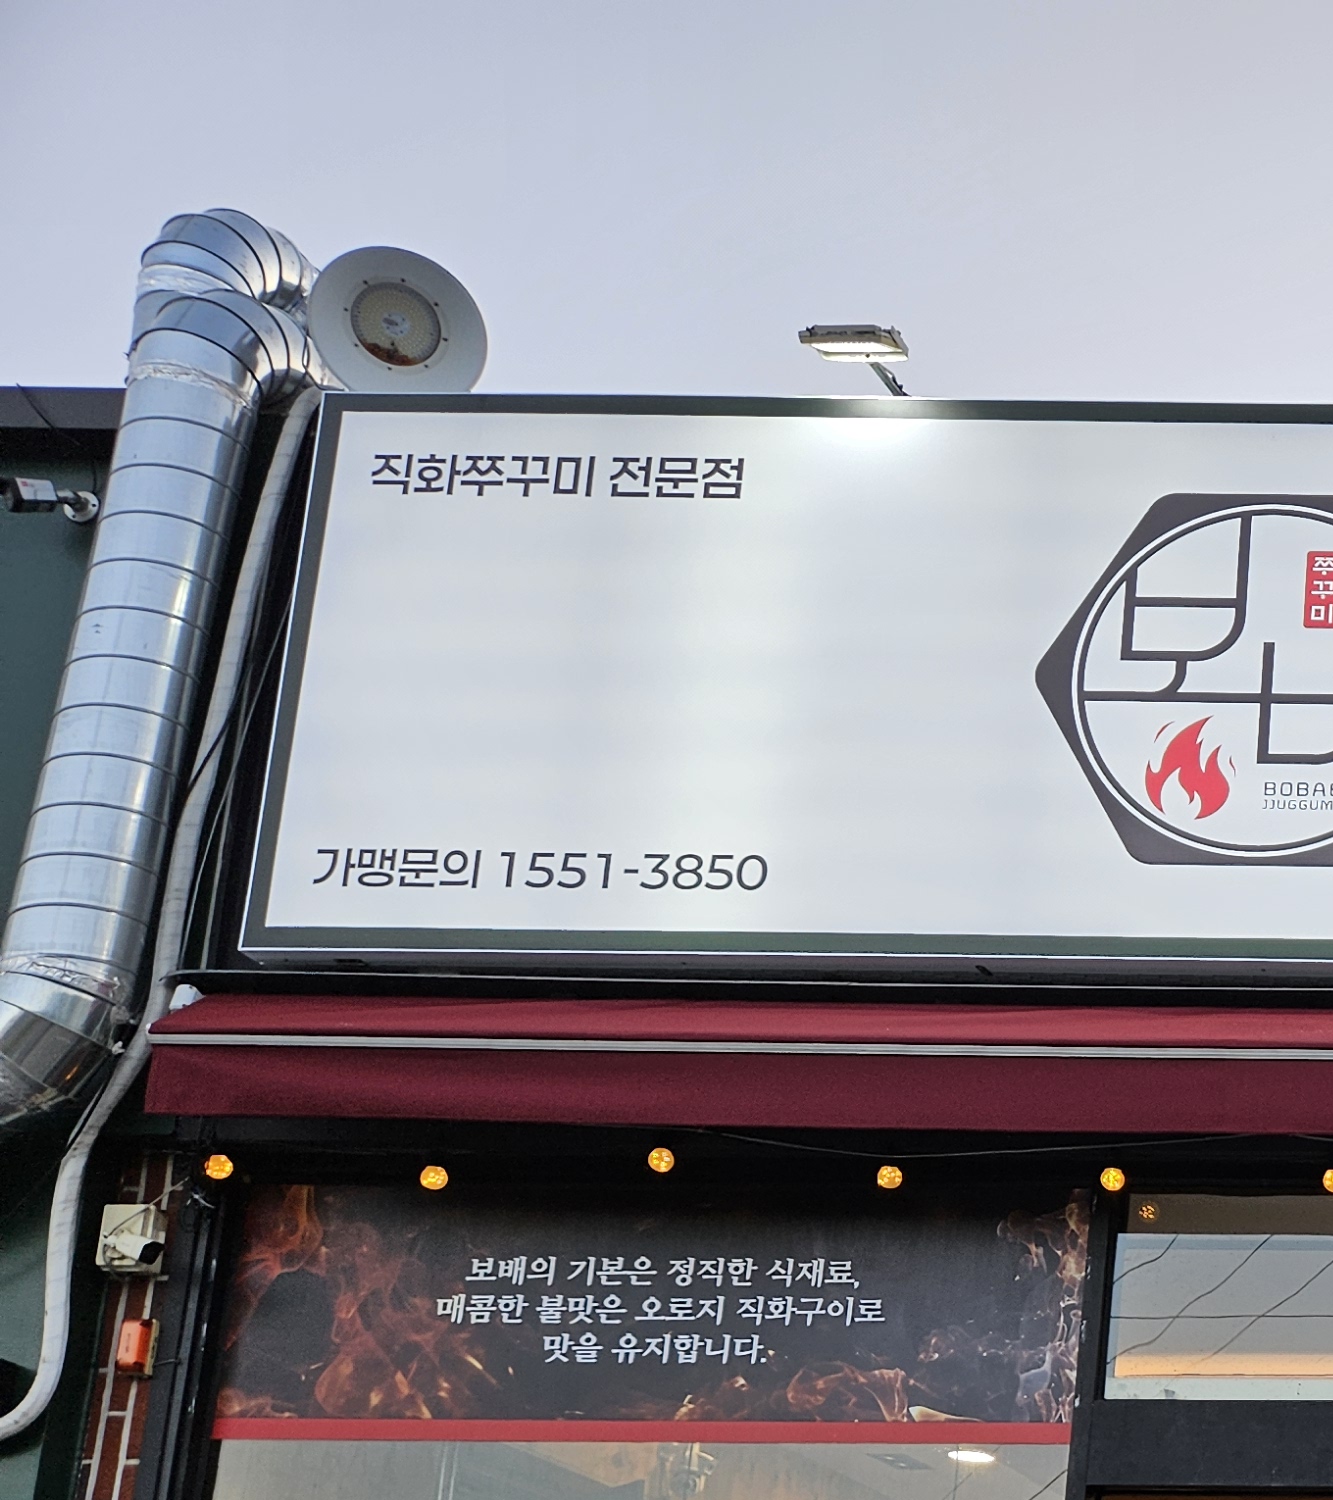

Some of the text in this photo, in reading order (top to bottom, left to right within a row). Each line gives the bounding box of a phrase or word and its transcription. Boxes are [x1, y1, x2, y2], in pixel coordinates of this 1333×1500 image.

[370, 453, 746, 500] 직화쭈꾸미 전문점
[311, 847, 769, 892] 가맹문의 1551-3850
[464, 1254, 860, 1292] 보배의 기본은 정직한 식재료,
[435, 1294, 886, 1328] 매콤한 불맛은 오로지 직화구이로
[542, 1332, 768, 1366] 맛을 유지합니다.
